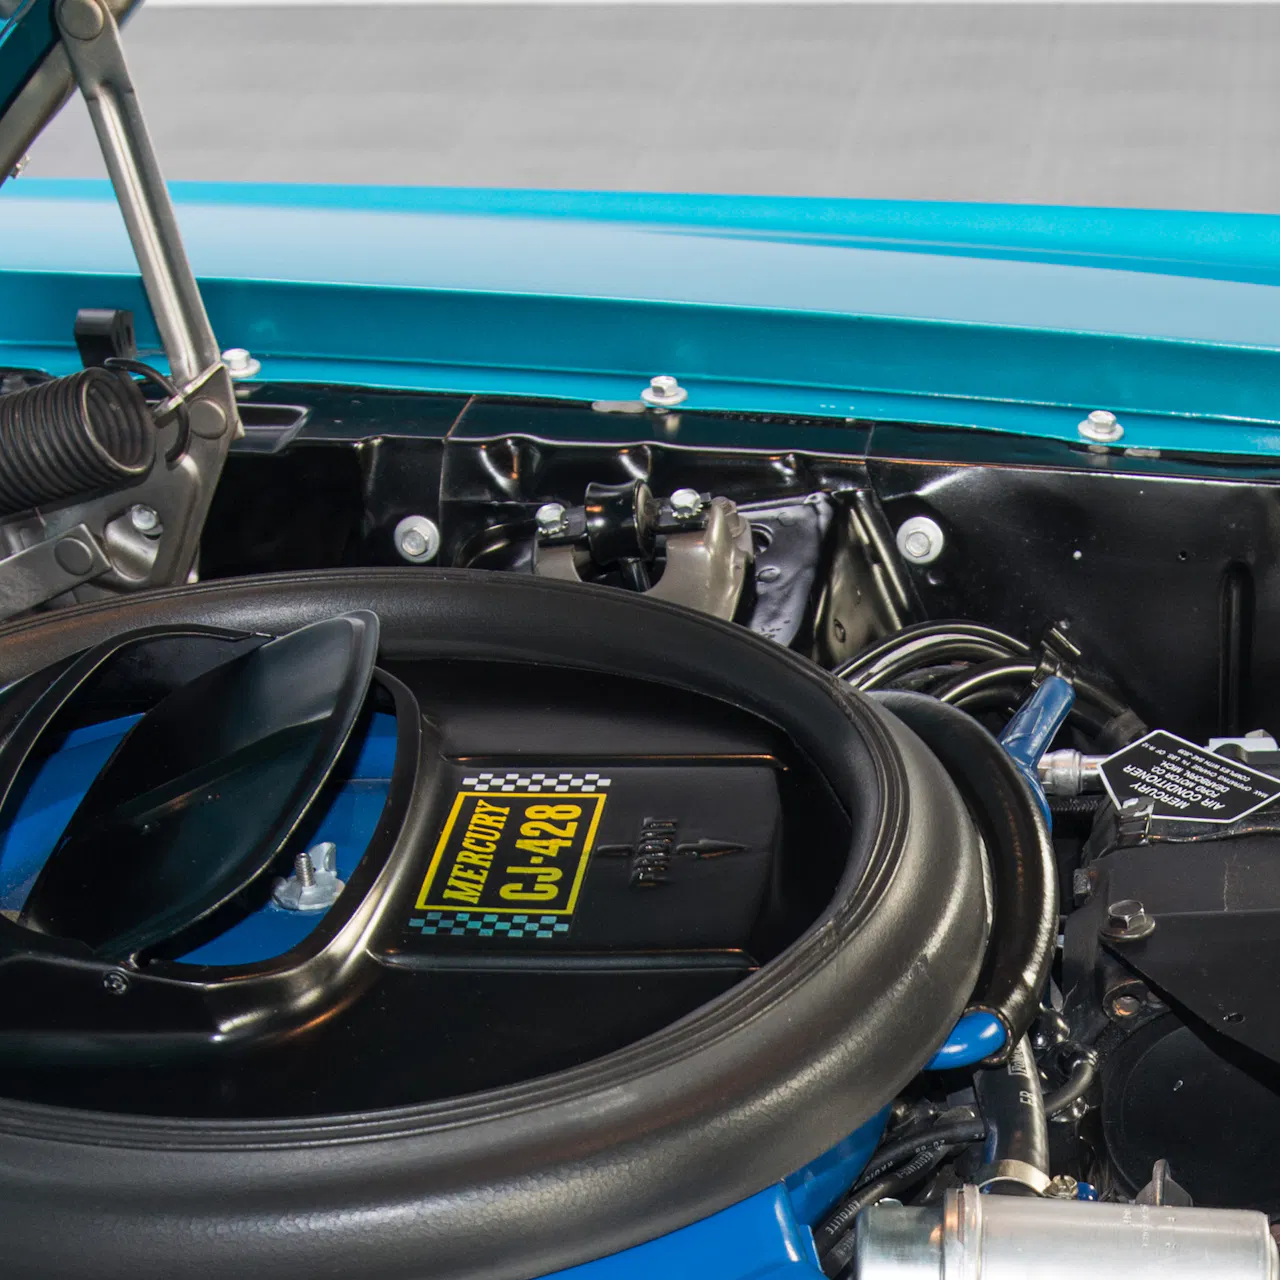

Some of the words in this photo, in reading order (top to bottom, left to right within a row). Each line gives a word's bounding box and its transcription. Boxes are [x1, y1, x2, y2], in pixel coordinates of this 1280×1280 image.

[1154, 748, 1166, 756] OF
[1150, 765, 1166, 776] CO.
[1159, 760, 1184, 774] MICH.
[1191, 763, 1218, 778] CHARGE
[1203, 759, 1221, 769] WITH
[1122, 764, 1203, 802] CONDITIONER
[1164, 772, 1198, 788] MOTOR
[1183, 768, 1230, 793] DEARBORN,
[1129, 781, 1190, 809] MERCURY
[1195, 785, 1220, 798] FORD
[1201, 797, 1226, 810] AIR
[442, 798, 511, 904] MERCURY
